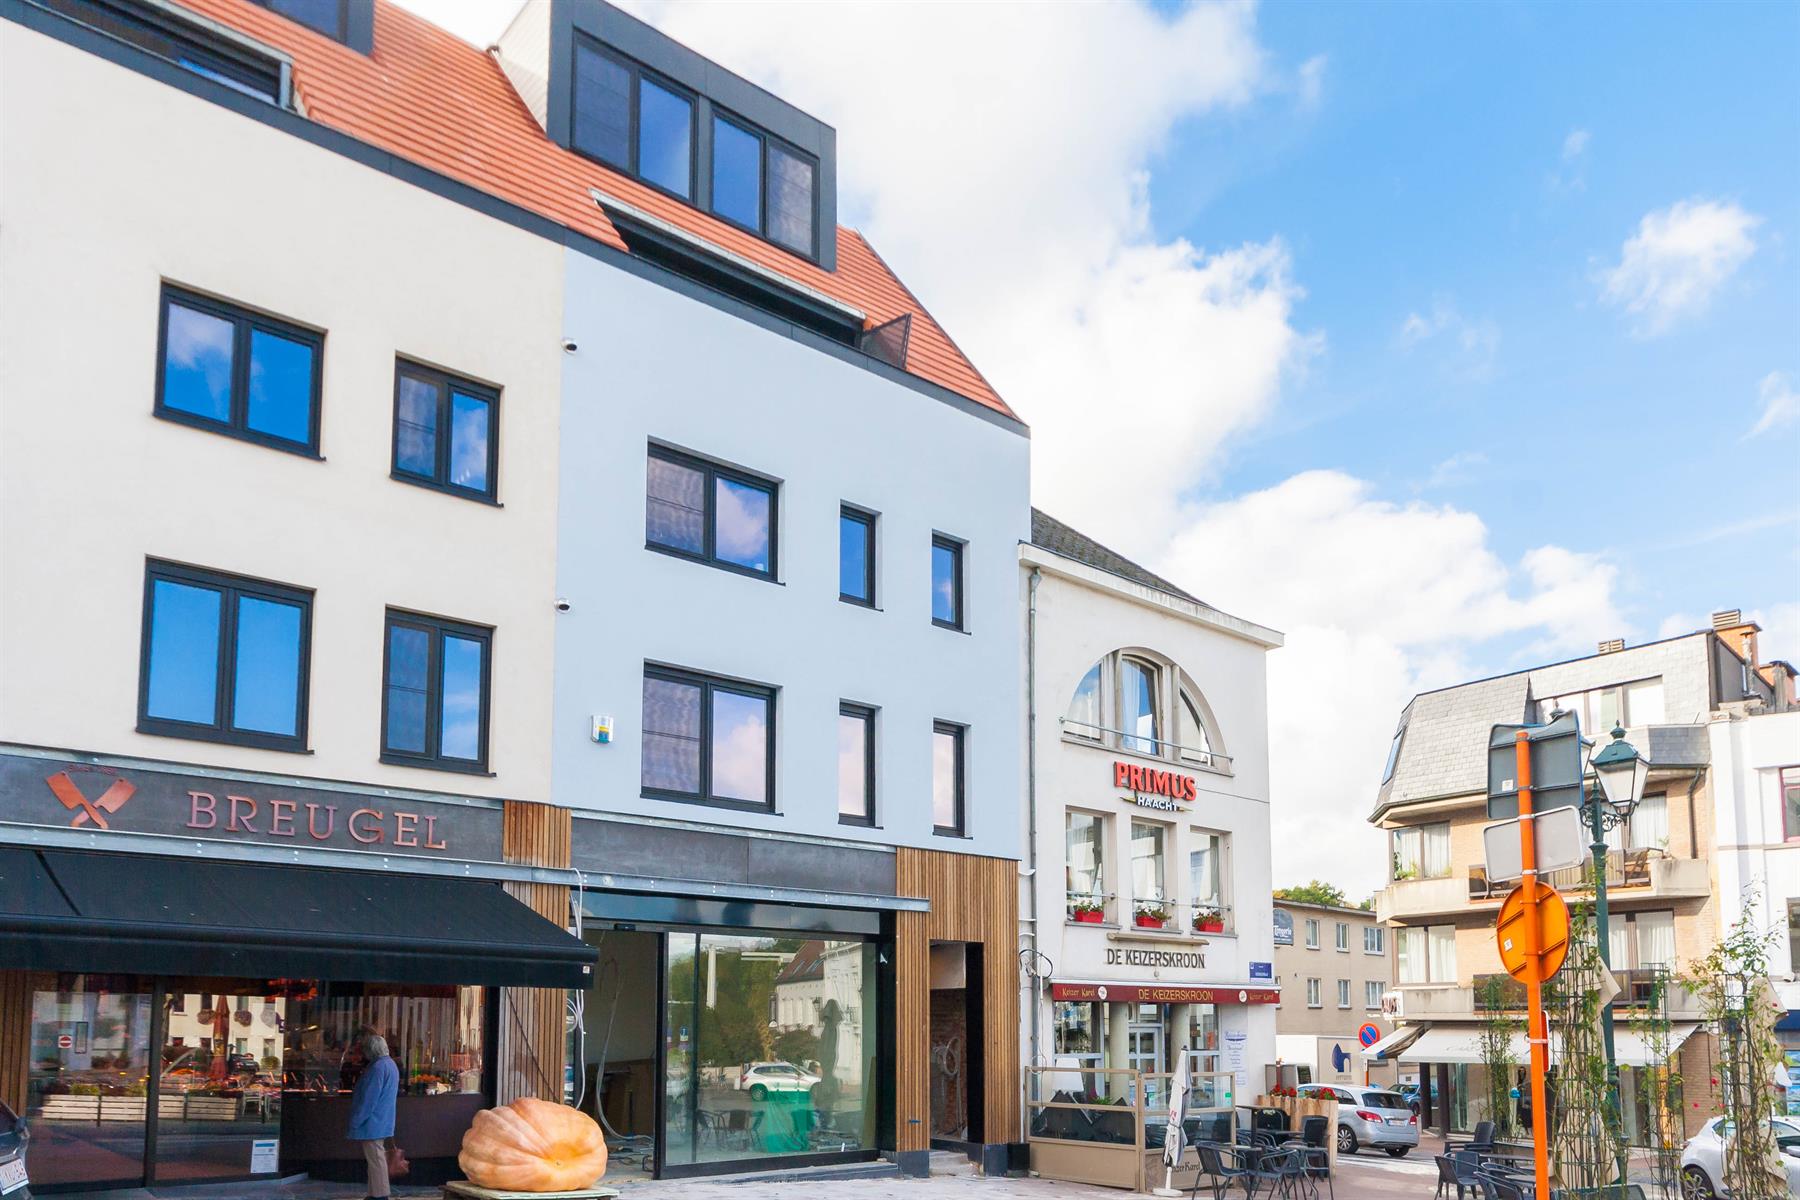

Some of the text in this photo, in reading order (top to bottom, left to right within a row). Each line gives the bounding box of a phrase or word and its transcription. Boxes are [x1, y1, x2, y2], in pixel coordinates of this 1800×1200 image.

[1114, 761, 1197, 801] PRIMUS
[1137, 796, 1178, 812] HAACHT
[186, 791, 447, 850] BREUGEL
[1107, 948, 1206, 969] DE KEIZERSKROON
[1138, 989, 1214, 1001] DE KEIZERSKROON
